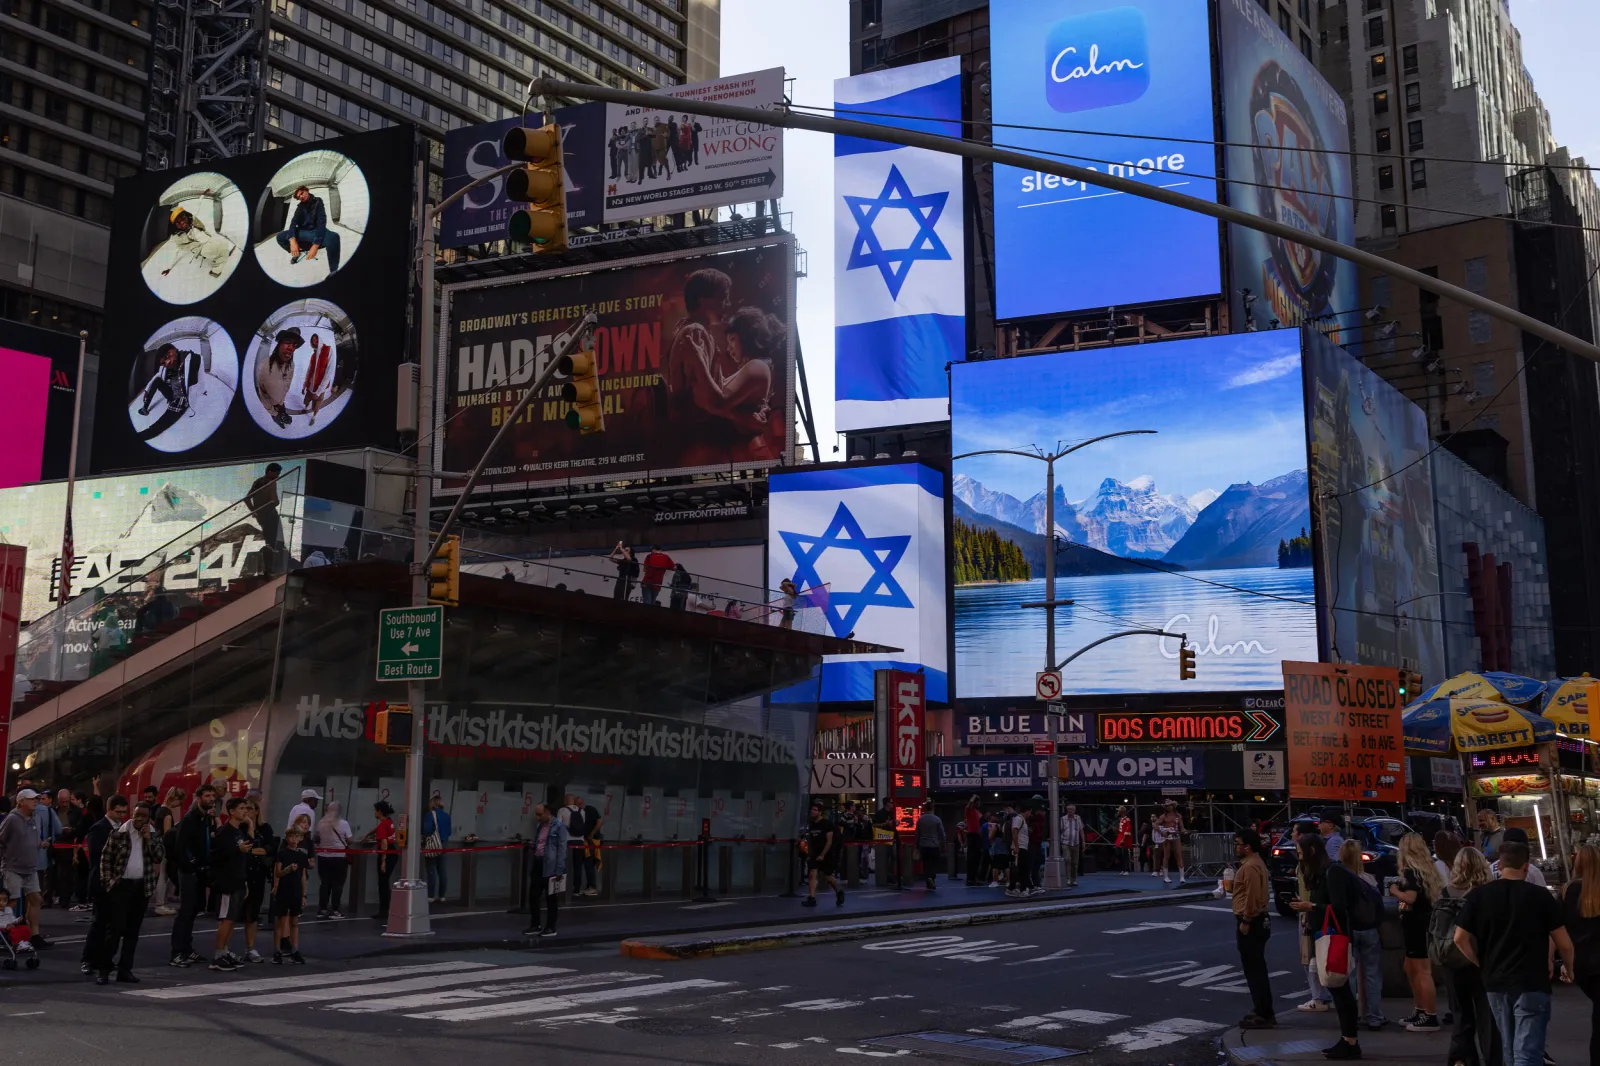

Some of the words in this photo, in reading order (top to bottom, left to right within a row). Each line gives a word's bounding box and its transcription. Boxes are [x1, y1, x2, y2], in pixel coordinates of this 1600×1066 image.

[1051, 44, 1143, 82] Calm
[675, 86, 711, 98] FUNNIEST
[714, 82, 739, 92] SMASH
[742, 79, 755, 88] HIT
[703, 88, 756, 101] PHENOMENON
[625, 108, 641, 117] AND
[703, 126, 733, 138] THAT
[703, 135, 777, 157] WRONG
[1108, 153, 1185, 178] more
[625, 195, 642, 204] NEW
[643, 191, 668, 201] WORLD
[669, 187, 695, 197] STAGES
[699, 185, 713, 193] 340
[741, 175, 766, 186] STREET
[490, 208, 507, 222] THE
[460, 312, 528, 333] BROADWAY'S
[531, 304, 586, 323] GREATEST
[591, 299, 621, 315] LOVE
[625, 293, 663, 310] STORY
[457, 321, 661, 392] HADESOWN
[457, 390, 501, 408] WINNER!
[601, 373, 660, 391] INCLUDING
[530, 462, 553, 472] WALTER
[553, 460, 569, 470] KERR
[598, 456, 609, 465] 219
[618, 454, 635, 463] 48TH
[654, 506, 748, 522] #OUTFRONTPRIME
[66, 619, 137, 634] Activeear
[386, 611, 437, 626] Southbound
[390, 627, 404, 640] Use
[407, 626, 413, 638] 7
[415, 626, 430, 638] Ave
[384, 664, 404, 678] Best
[407, 661, 432, 675] Route
[1288, 674, 1332, 705] ROAD
[1336, 677, 1396, 709] CLOSED
[896, 678, 920, 767] tkts
[969, 715, 1031, 733] BLUE
[1104, 717, 1143, 740] DOS
[1149, 715, 1243, 739] CAMINOS
[1299, 709, 1331, 726] WEST
[1334, 712, 1345, 726] 47
[1348, 713, 1390, 728] STREET
[970, 734, 1029, 744] SEAFOOD
[1293, 731, 1312, 747] BET.
[1314, 733, 1320, 746] 7
[1321, 733, 1341, 748] AVE.
[1343, 733, 1349, 748] &
[1361, 735, 1367, 749] 8
[1368, 735, 1377, 749] th
[1378, 736, 1397, 750] AVE.
[1457, 729, 1529, 748] SABRETT
[1117, 757, 1194, 778] OPEN
[1311, 751, 1337, 767] SEPT.
[1357, 753, 1377, 769] OCT.
[1380, 754, 1385, 769] 6
[942, 762, 989, 778] BLUE
[998, 762, 1028, 778] FIN
[1303, 772, 1334, 787] 12:01
[1365, 774, 1371, 788] 6
[479, 791, 489, 806] 4
[525, 791, 533, 807] 5
[644, 796, 651, 809] 8
[714, 799, 724, 812] 10
[776, 799, 786, 812] 12
